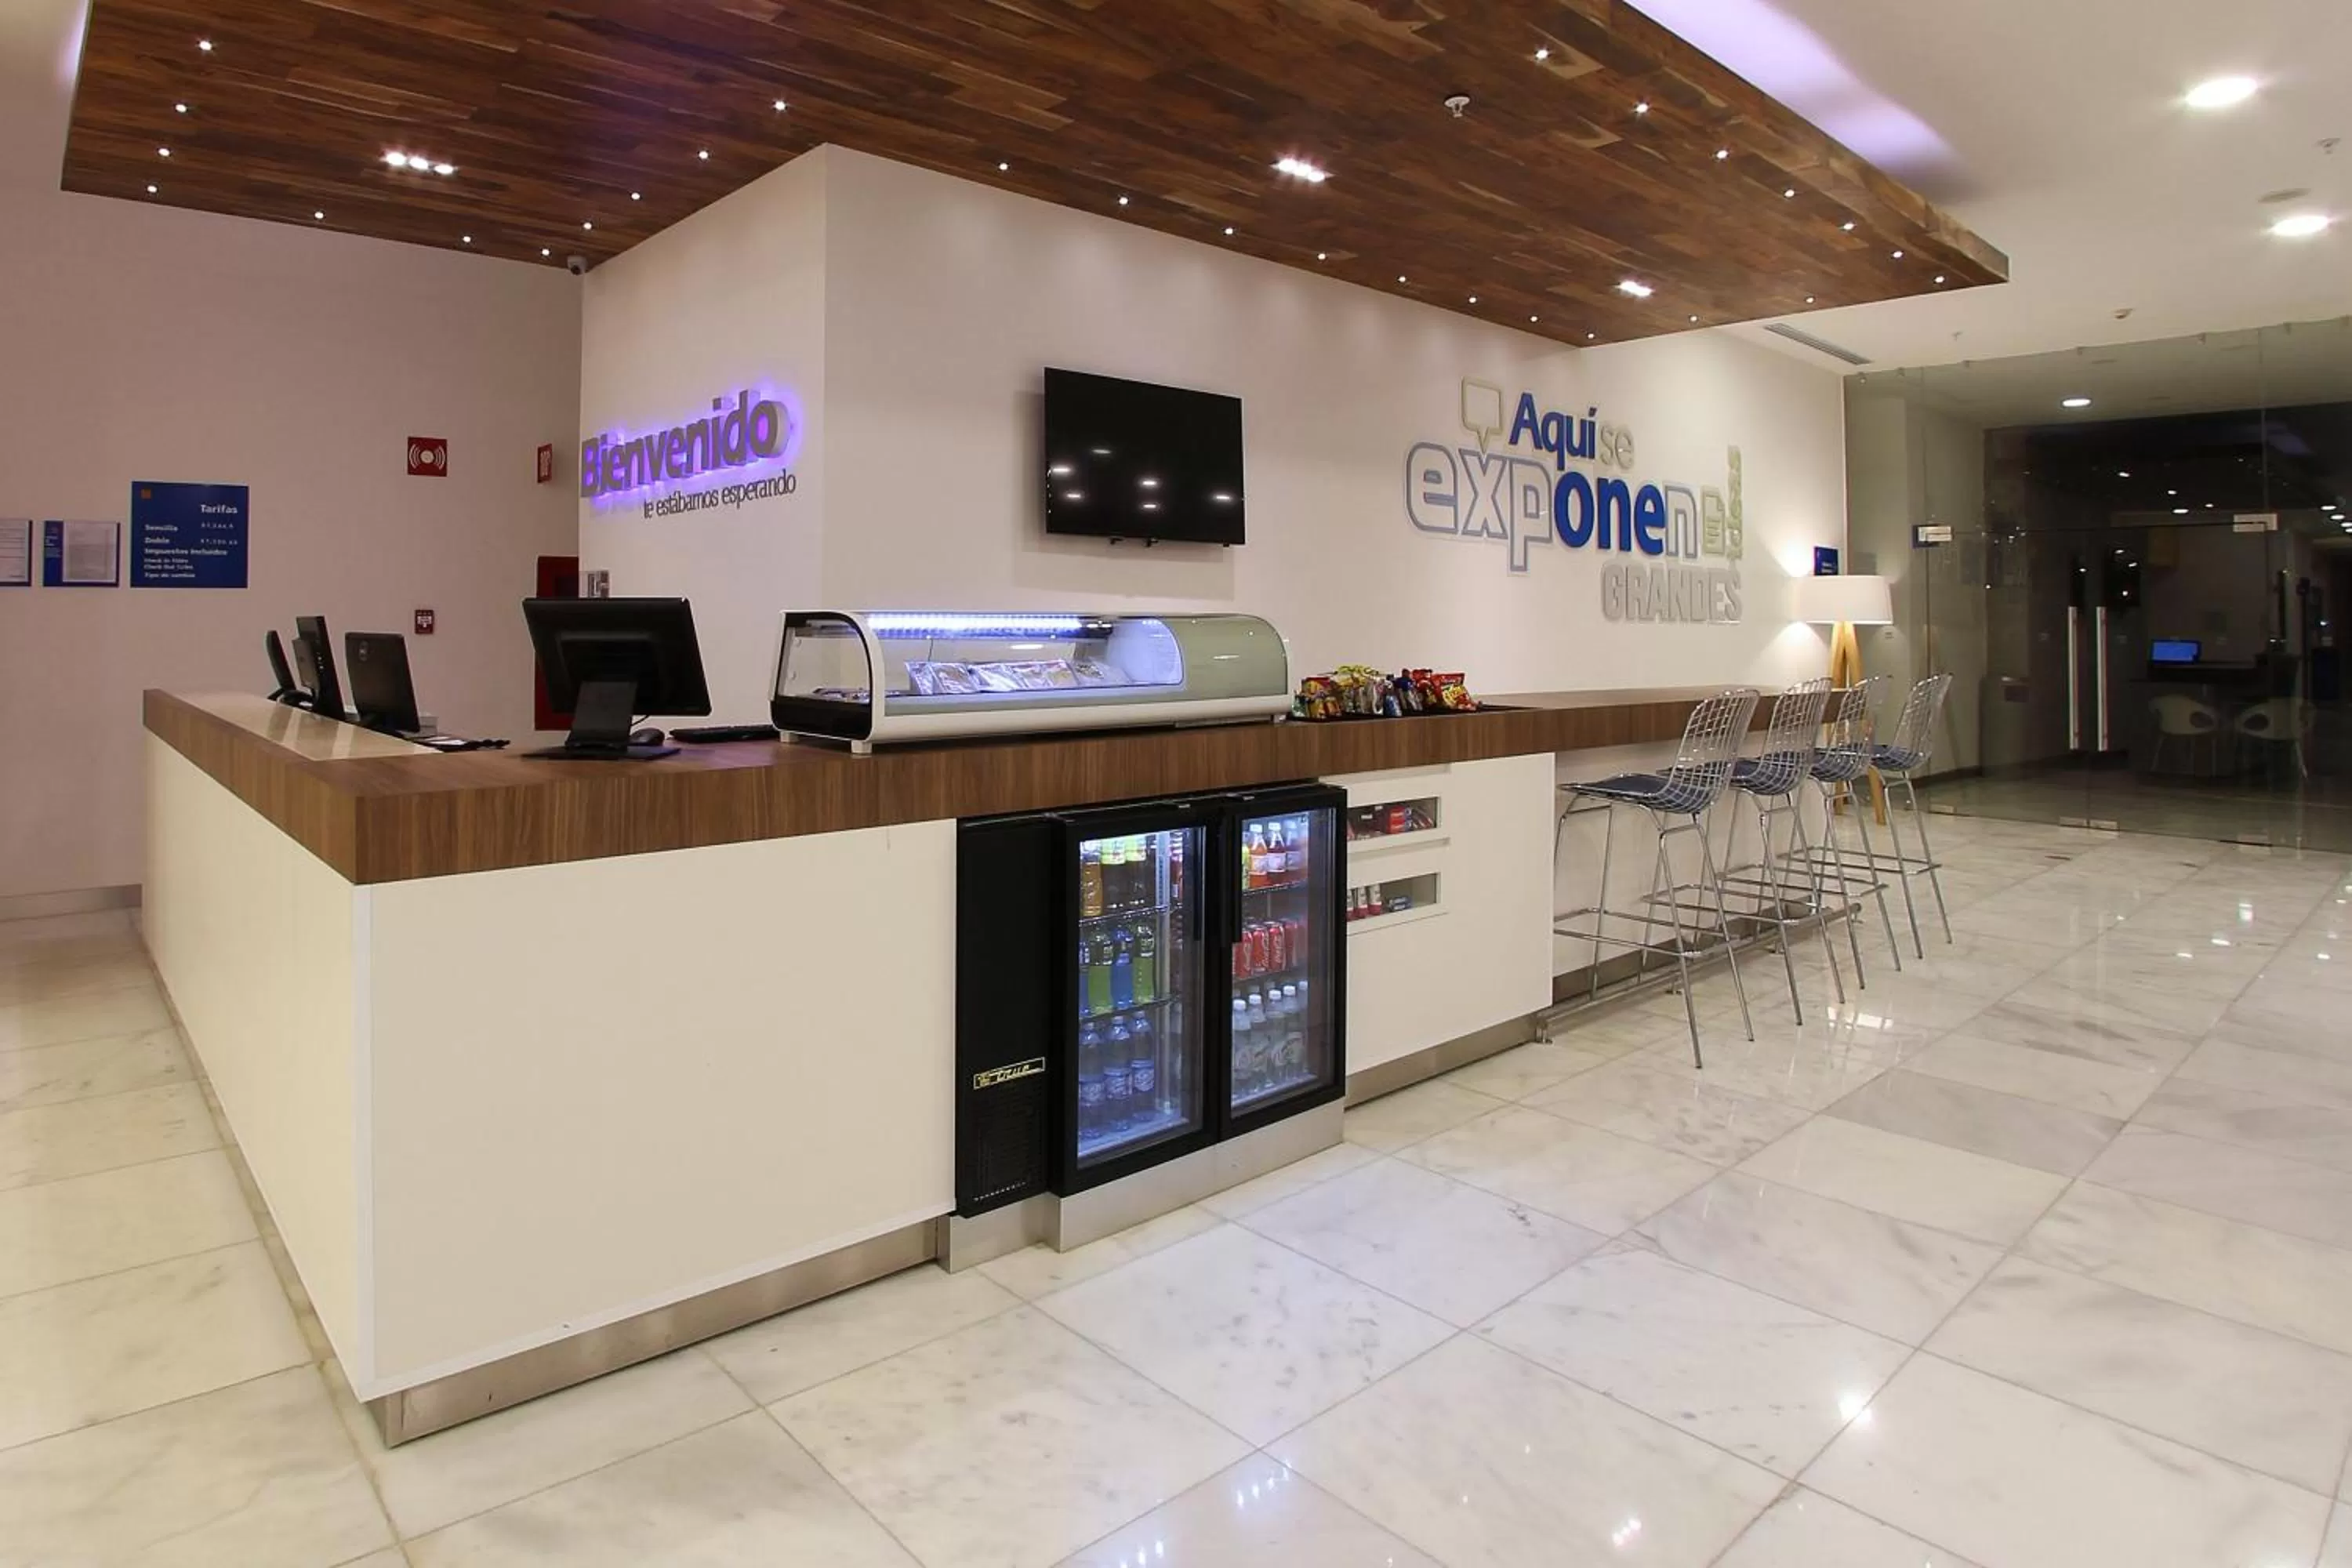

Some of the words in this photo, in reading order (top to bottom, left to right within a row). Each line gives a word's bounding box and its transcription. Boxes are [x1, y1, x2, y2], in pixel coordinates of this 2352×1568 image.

[580, 390, 788, 498] Bienvenido
[1509, 392, 1598, 470] Aquí
[1599, 421, 1635, 470] se
[201, 504, 238, 514] Tarifas
[644, 499, 654, 519] te
[656, 489, 719, 517] estábamos
[721, 468, 797, 509] esperando
[1602, 563, 1741, 623] GRANDES
